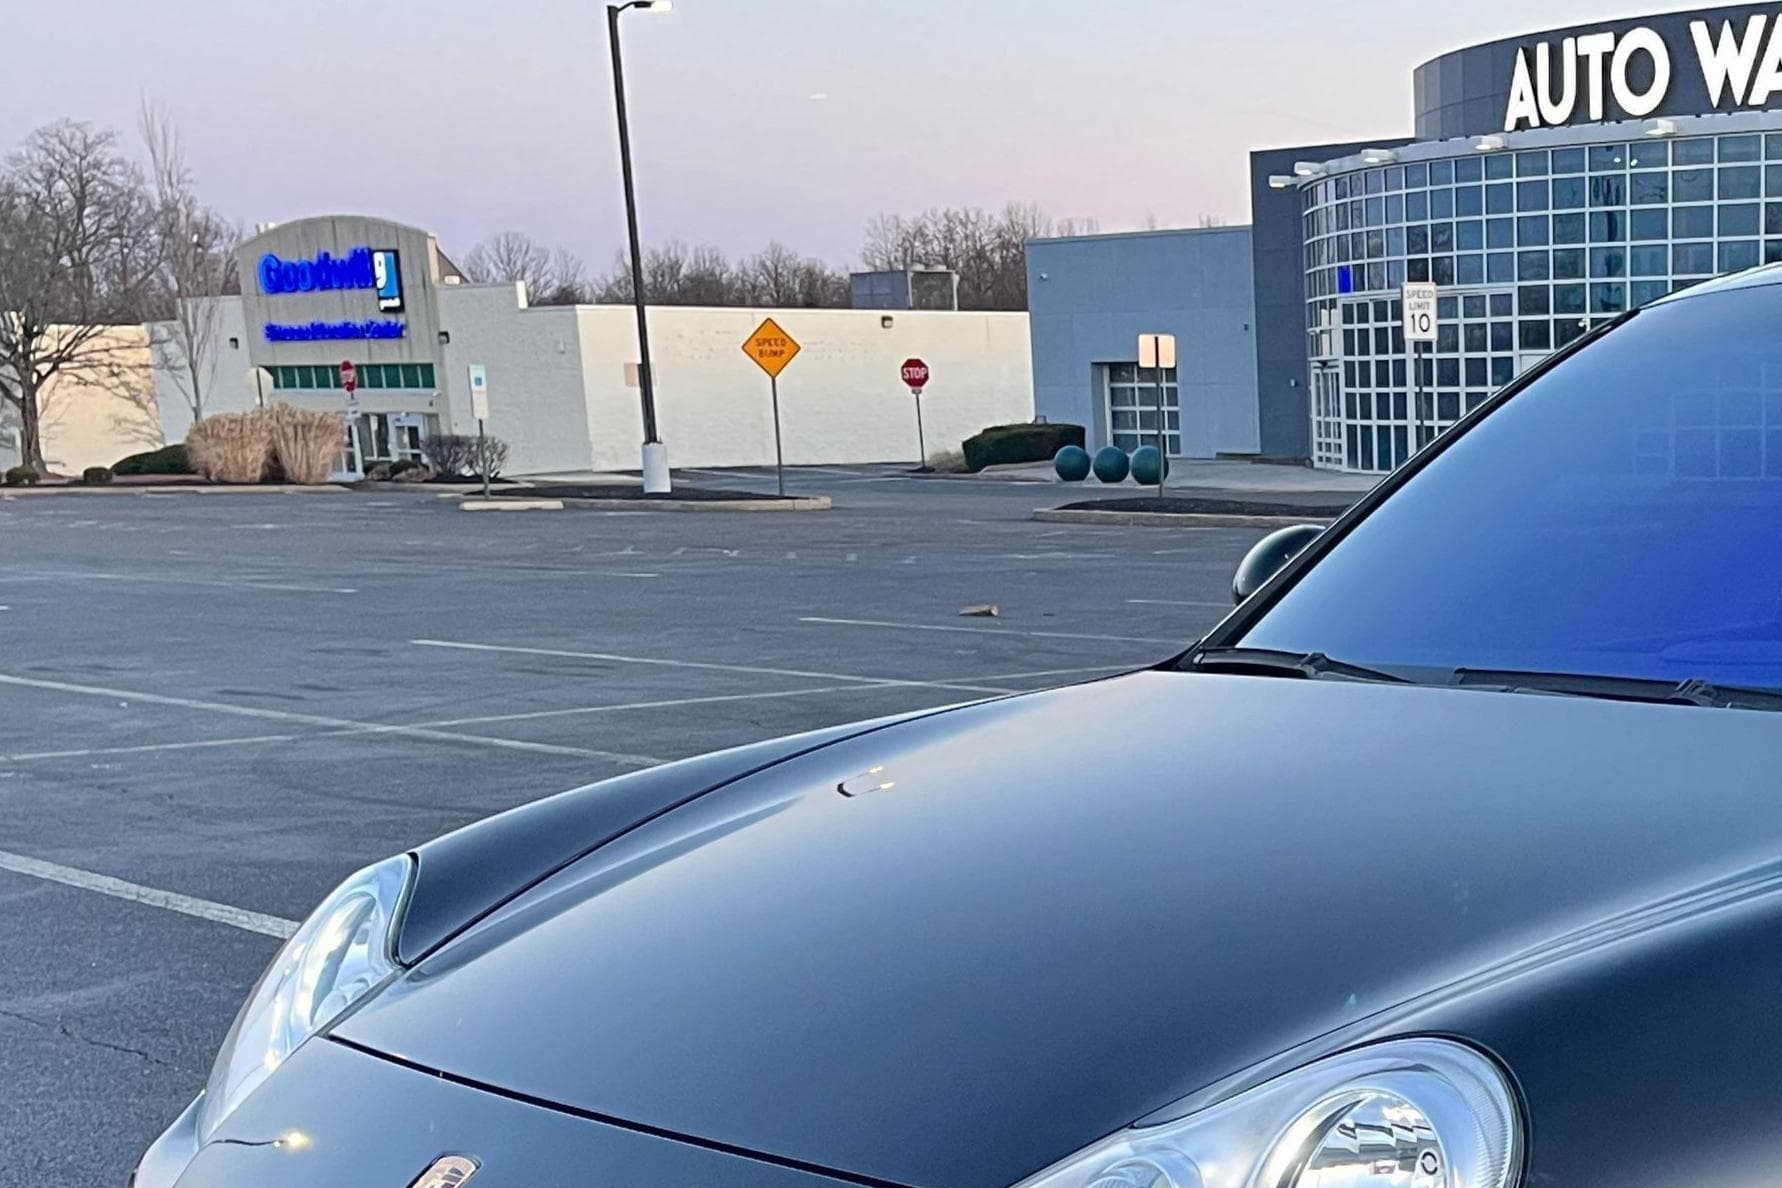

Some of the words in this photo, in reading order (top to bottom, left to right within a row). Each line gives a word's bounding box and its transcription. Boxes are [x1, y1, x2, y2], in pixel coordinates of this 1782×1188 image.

[1504, 27, 1671, 132] AUTO
[1407, 289, 1434, 299] SPEED
[1409, 301, 1430, 310] LIMIT
[1411, 313, 1431, 333] 10
[755, 338, 787, 347] SPEED
[758, 349, 786, 358] BUMP
[903, 367, 927, 379] STOP
